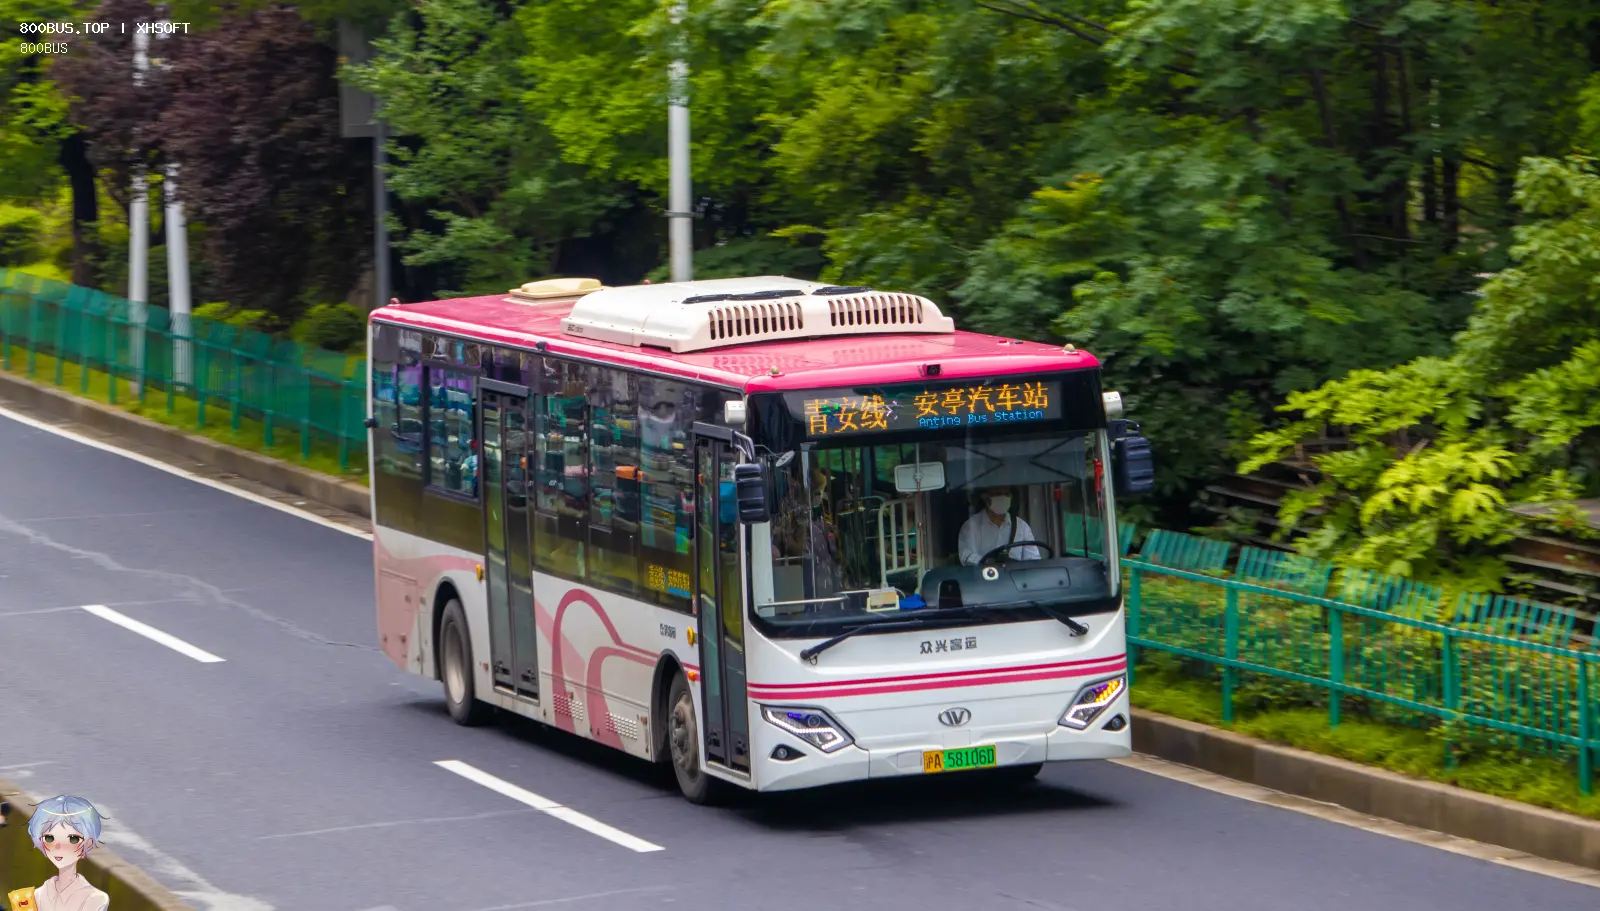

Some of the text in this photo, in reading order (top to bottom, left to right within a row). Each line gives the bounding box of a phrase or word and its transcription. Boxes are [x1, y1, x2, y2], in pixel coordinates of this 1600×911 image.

[803, 381, 1049, 435] 青安线 安亭汽车站
[919, 409, 1043, 429] Anting Bus Station
[920, 636, 977, 655] 众兴客运
